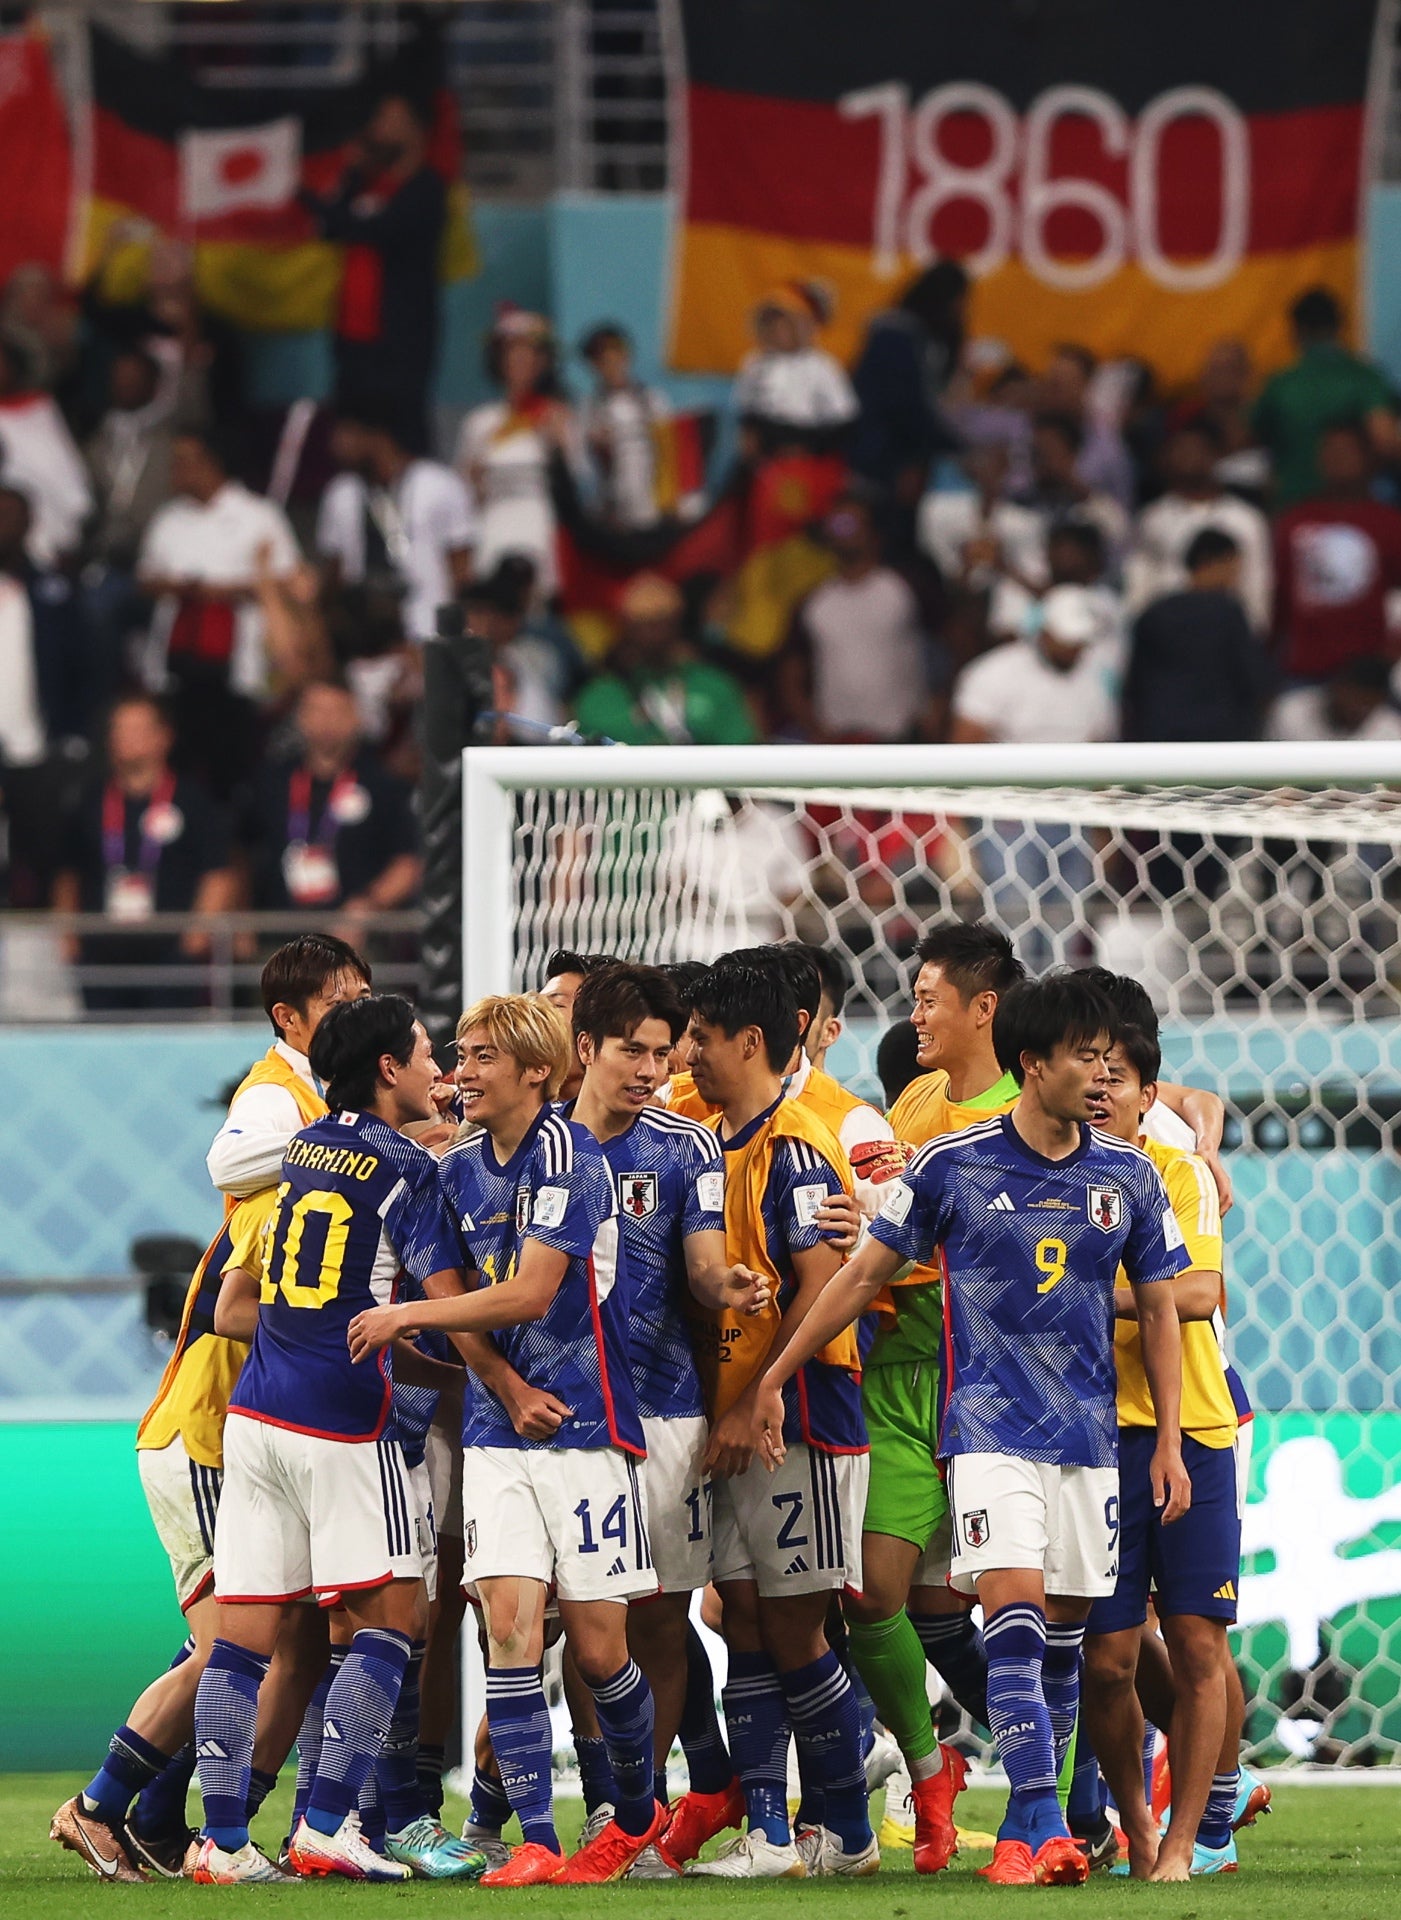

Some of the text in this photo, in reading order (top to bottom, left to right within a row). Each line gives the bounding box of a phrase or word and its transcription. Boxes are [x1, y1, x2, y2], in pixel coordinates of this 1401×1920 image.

[839, 82, 1250, 291] 1860
[259, 1181, 354, 1310] 10
[1035, 1237, 1067, 1294] 9
[573, 1494, 627, 1553] 14
[771, 1491, 808, 1549] 2
